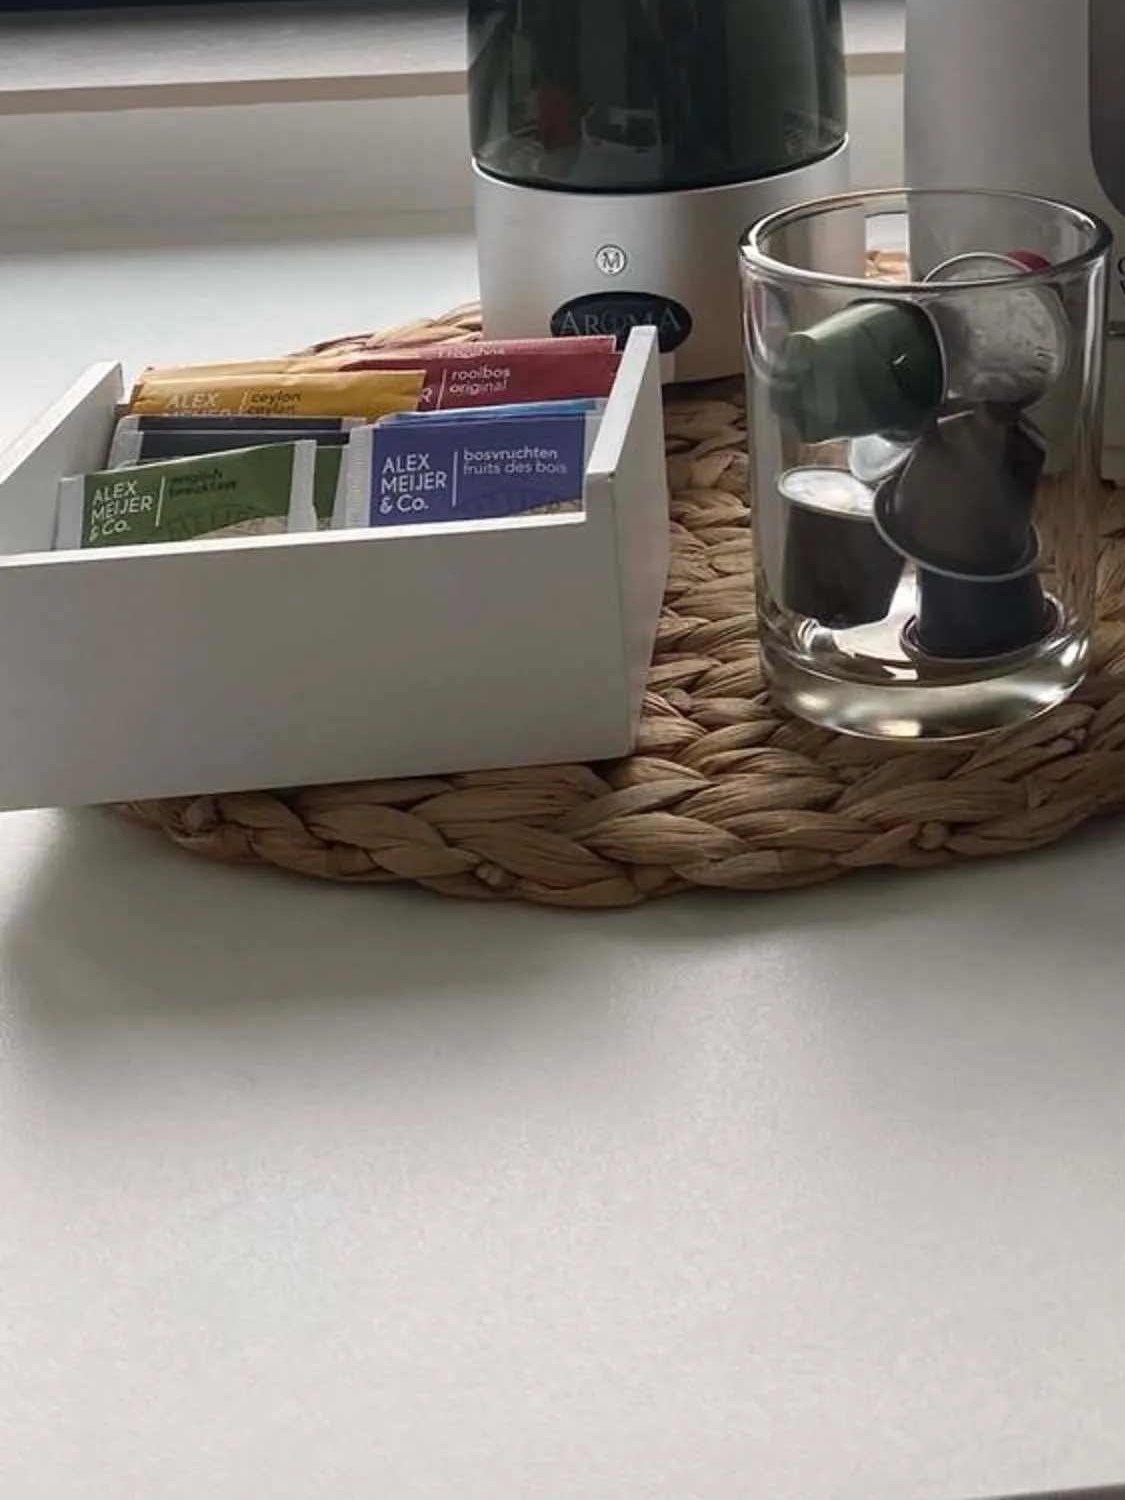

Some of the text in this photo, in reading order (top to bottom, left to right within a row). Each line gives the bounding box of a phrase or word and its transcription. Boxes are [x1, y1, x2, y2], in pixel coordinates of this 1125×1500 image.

[451, 366, 511, 381] rooibos
[449, 379, 508, 395] original
[167, 391, 219, 409] ALEX
[251, 390, 301, 405] ceylon
[463, 447, 558, 462] bosvruchten
[382, 453, 430, 476] ALEX
[462, 459, 568, 477] fruits des bois
[93, 480, 139, 504] ALEX
[380, 472, 447, 495] MEIJER
[91, 496, 153, 526] MEIJER
[379, 493, 429, 515] & Co.
[101, 518, 132, 536] Co.
